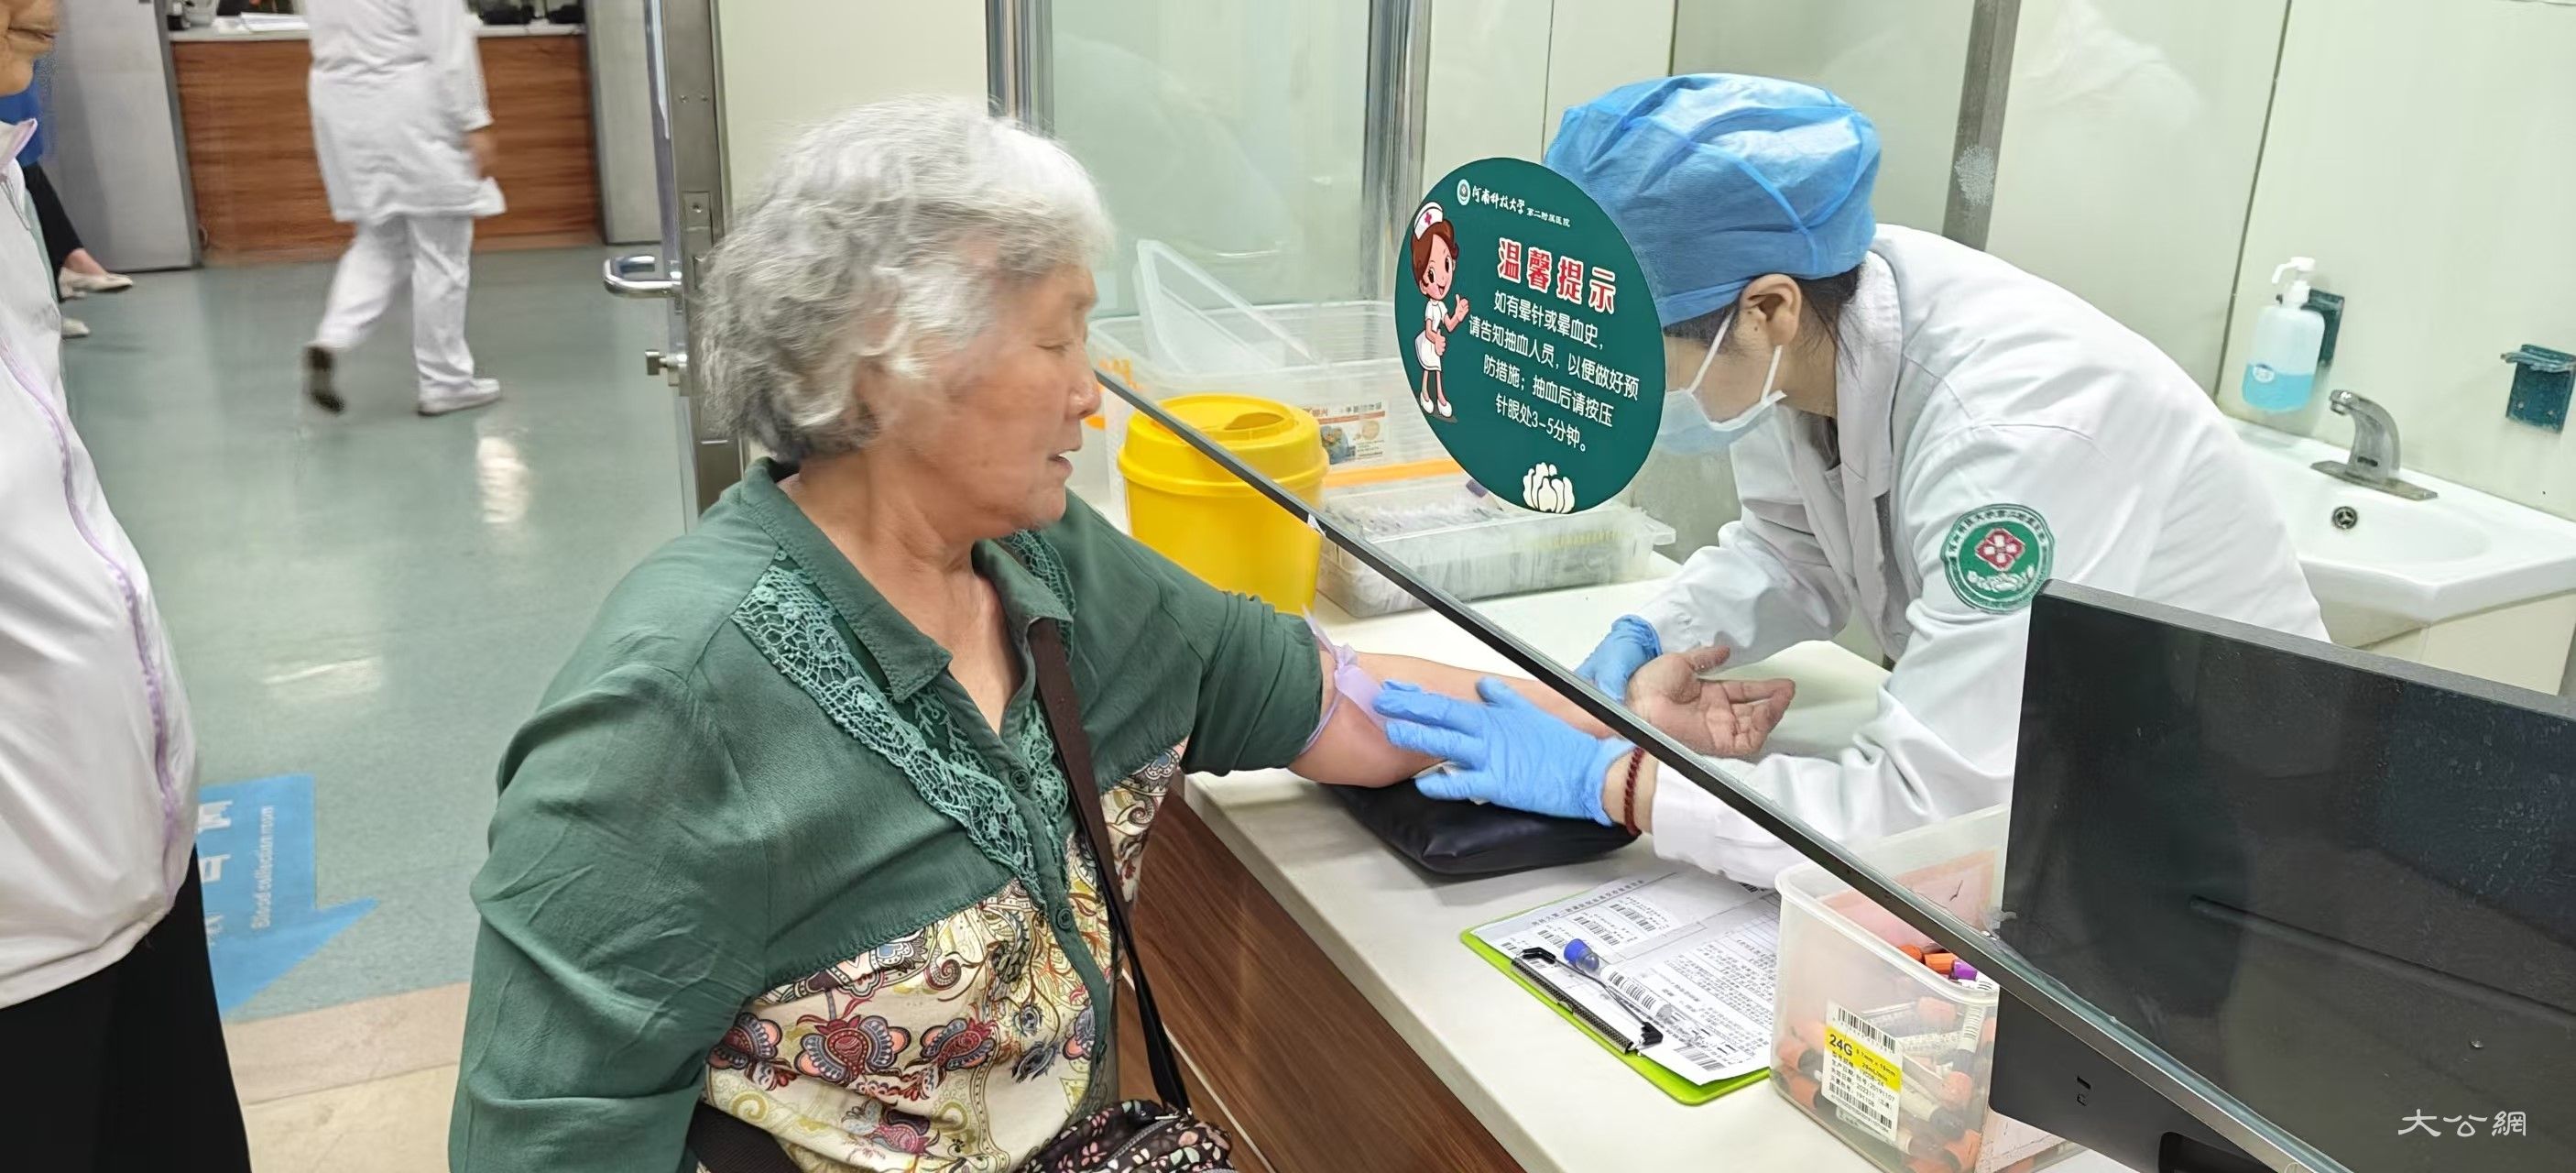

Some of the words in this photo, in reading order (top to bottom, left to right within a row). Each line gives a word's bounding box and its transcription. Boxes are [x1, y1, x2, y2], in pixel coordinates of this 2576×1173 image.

[1472, 185, 1525, 214] 河南科技大学
[1526, 207, 1571, 227] 第二附属医院
[1497, 236, 1617, 315] 温馨提示
[1494, 291, 1603, 350] 如有晕针或晕血史，
[1829, 1034, 1852, 1057] 24G
